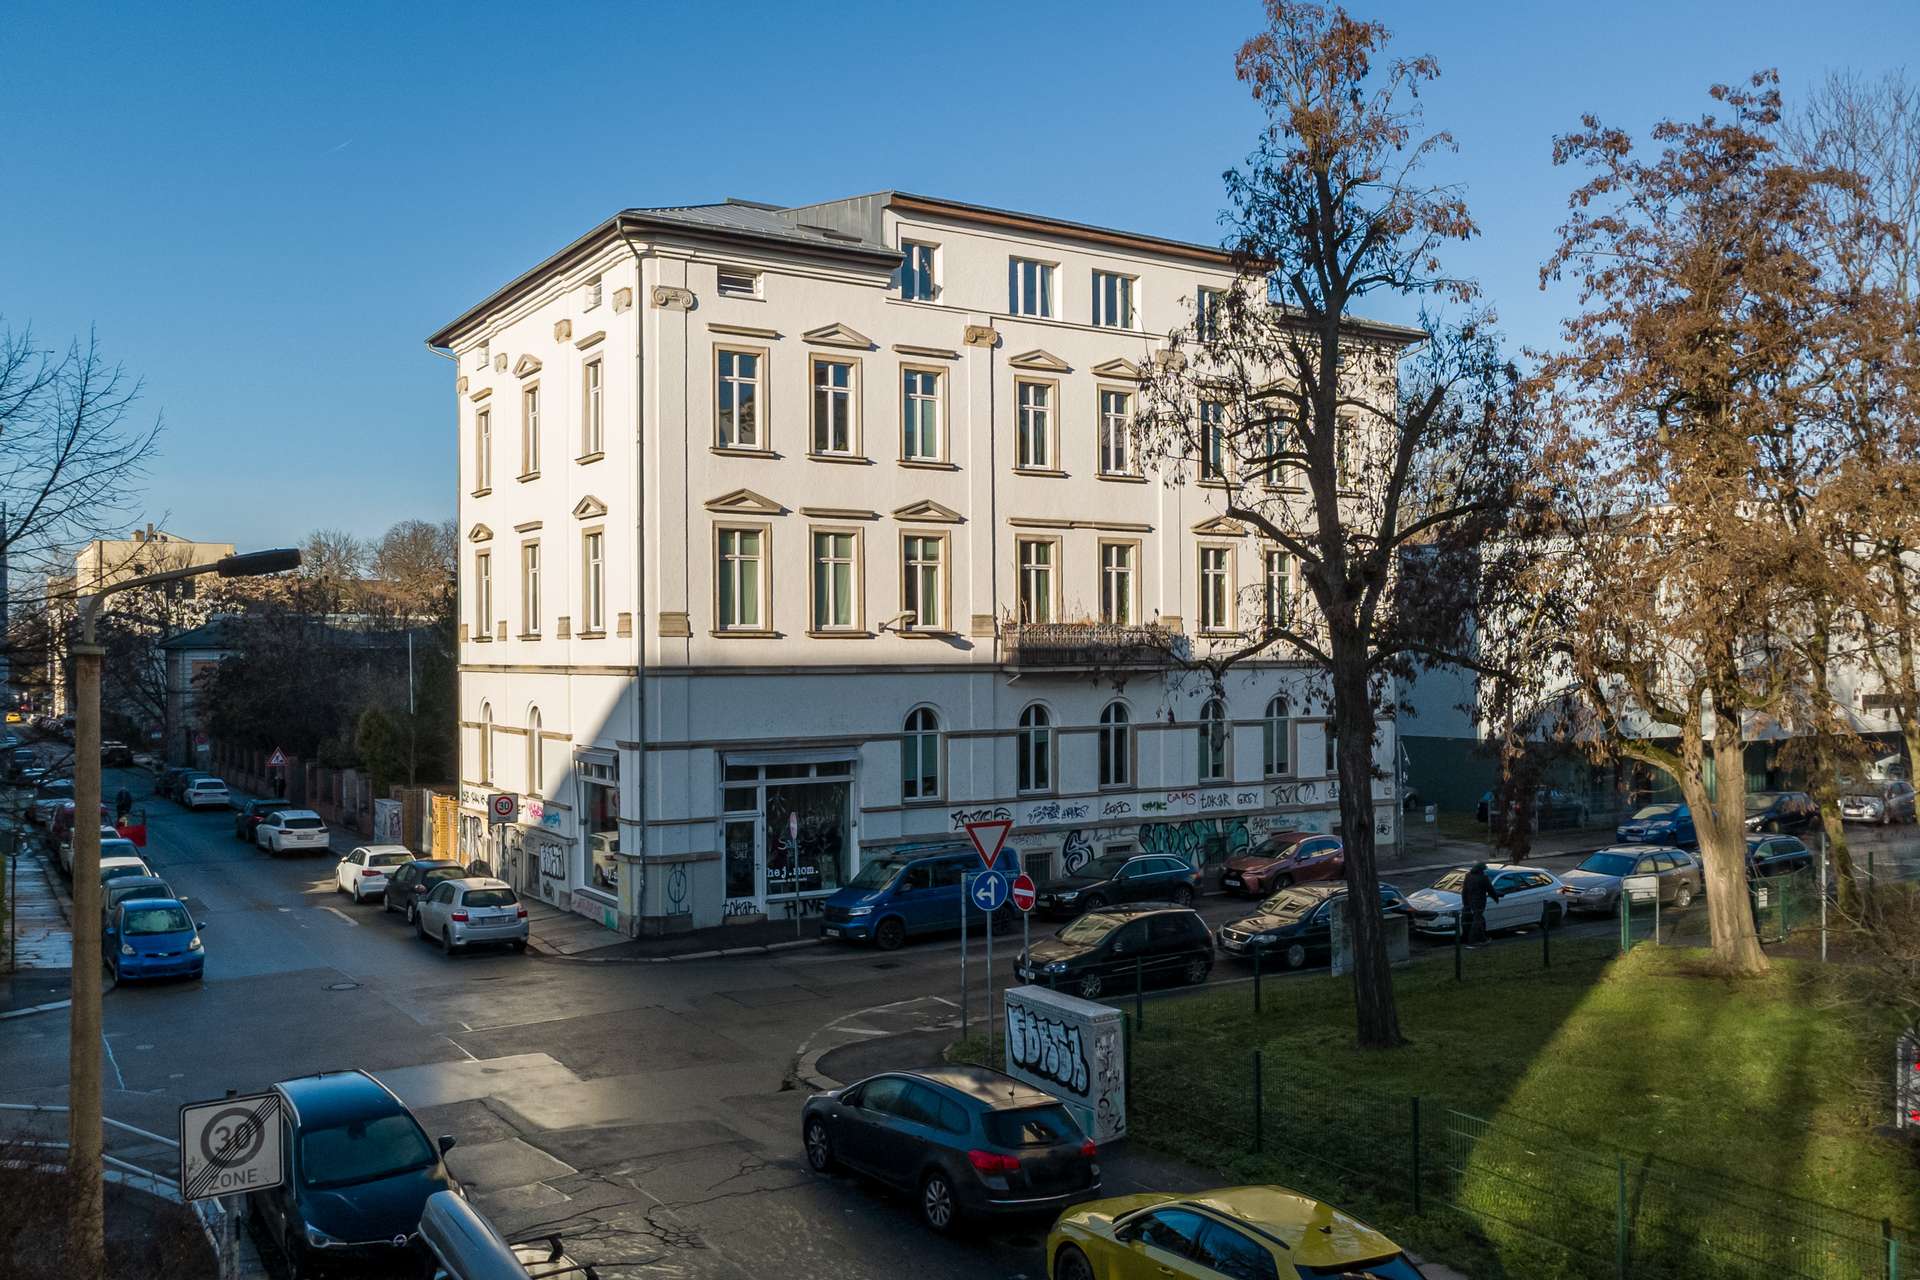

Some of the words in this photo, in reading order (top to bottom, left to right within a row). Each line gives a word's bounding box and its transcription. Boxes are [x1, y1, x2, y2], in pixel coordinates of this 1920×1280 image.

[498, 800, 510, 811] 30
[214, 1122, 252, 1153] 30
[208, 1168, 258, 1191] ZONE
